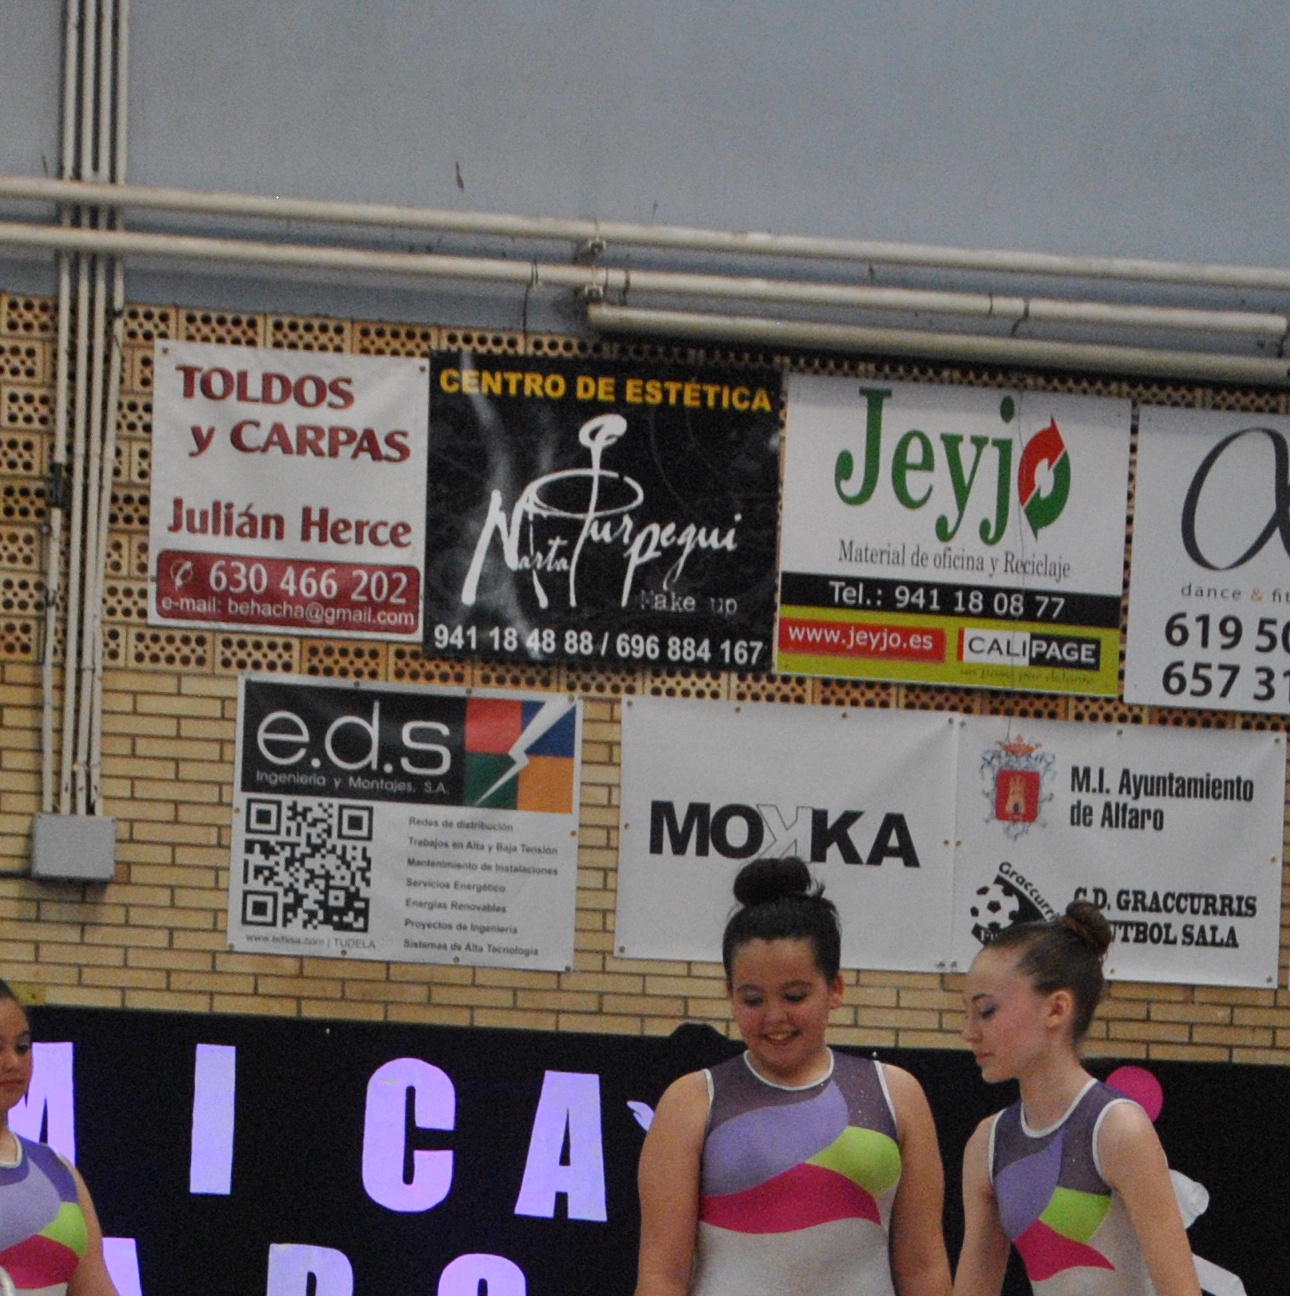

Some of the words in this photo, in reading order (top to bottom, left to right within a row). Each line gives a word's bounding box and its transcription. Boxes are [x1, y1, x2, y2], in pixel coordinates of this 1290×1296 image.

[174, 364, 356, 411] TOLDOS
[439, 367, 567, 398] CENTRO
[575, 375, 617, 401] DE
[188, 425, 216, 458] y
[229, 419, 412, 463] CARPAS
[834, 386, 1072, 546] Jeyjo
[168, 496, 285, 541] Julián
[300, 506, 413, 549] Herce
[838, 539, 906, 567] Material
[910, 543, 930, 567] de
[933, 546, 986, 573] oficina
[989, 554, 1000, 578] y
[1003, 550, 1072, 583] Reciclaje
[208, 559, 268, 595] 630
[279, 565, 339, 600] 466
[350, 569, 409, 605] 202
[1180, 582, 1243, 600] dance
[161, 597, 222, 614] e-mail:
[227, 598, 416, 627] behacha@gmail.com
[640, 590, 697, 613] Make
[710, 596, 738, 617] up
[828, 580, 884, 607] Tel.:
[895, 585, 941, 610] 941
[954, 589, 984, 614] 18
[993, 592, 1025, 617] 08
[1034, 595, 1065, 620] 77
[434, 624, 478, 650] 941
[488, 626, 518, 651] 18
[525, 628, 556, 654] 48
[564, 630, 594, 655] 88
[615, 633, 660, 660] 696
[666, 636, 711, 663] 884
[720, 639, 765, 665] 167
[788, 624, 934, 652] www.jeyjo.es
[1164, 611, 1244, 650] 619
[1161, 659, 1241, 699] 657
[255, 699, 453, 777] e.d.s
[333, 774, 343, 790] y
[1070, 765, 1110, 794] M.I.
[1118, 768, 1254, 802] Ayuntamiento
[409, 816, 439, 827] Redes
[441, 818, 454, 828] de
[1070, 800, 1093, 827] de
[1100, 801, 1165, 831] Alfaro
[409, 836, 450, 850] Trabajos
[452, 840, 464, 849] en
[466, 840, 485, 851] Alta
[487, 843, 493, 852] y
[496, 842, 518, 854] Baja
[407, 857, 478, 871] Mantenimiento
[480, 861, 492, 871] de
[494, 862, 559, 876] Instalaciones
[406, 877, 451, 890] Servicios
[999, 861, 1059, 922] Graccurri
[450, 900, 507, 913] Renovables
[1116, 888, 1258, 918] GRACCURRIS
[404, 918, 453, 931] Proyectos
[456, 921, 468, 931] de
[1108, 920, 1179, 946] TBOL
[1181, 923, 1240, 949] SALA
[334, 938, 376, 949] TUDELA
[403, 938, 448, 951] Sistemas
[450, 941, 462, 951] de
[465, 942, 484, 953] Alta
